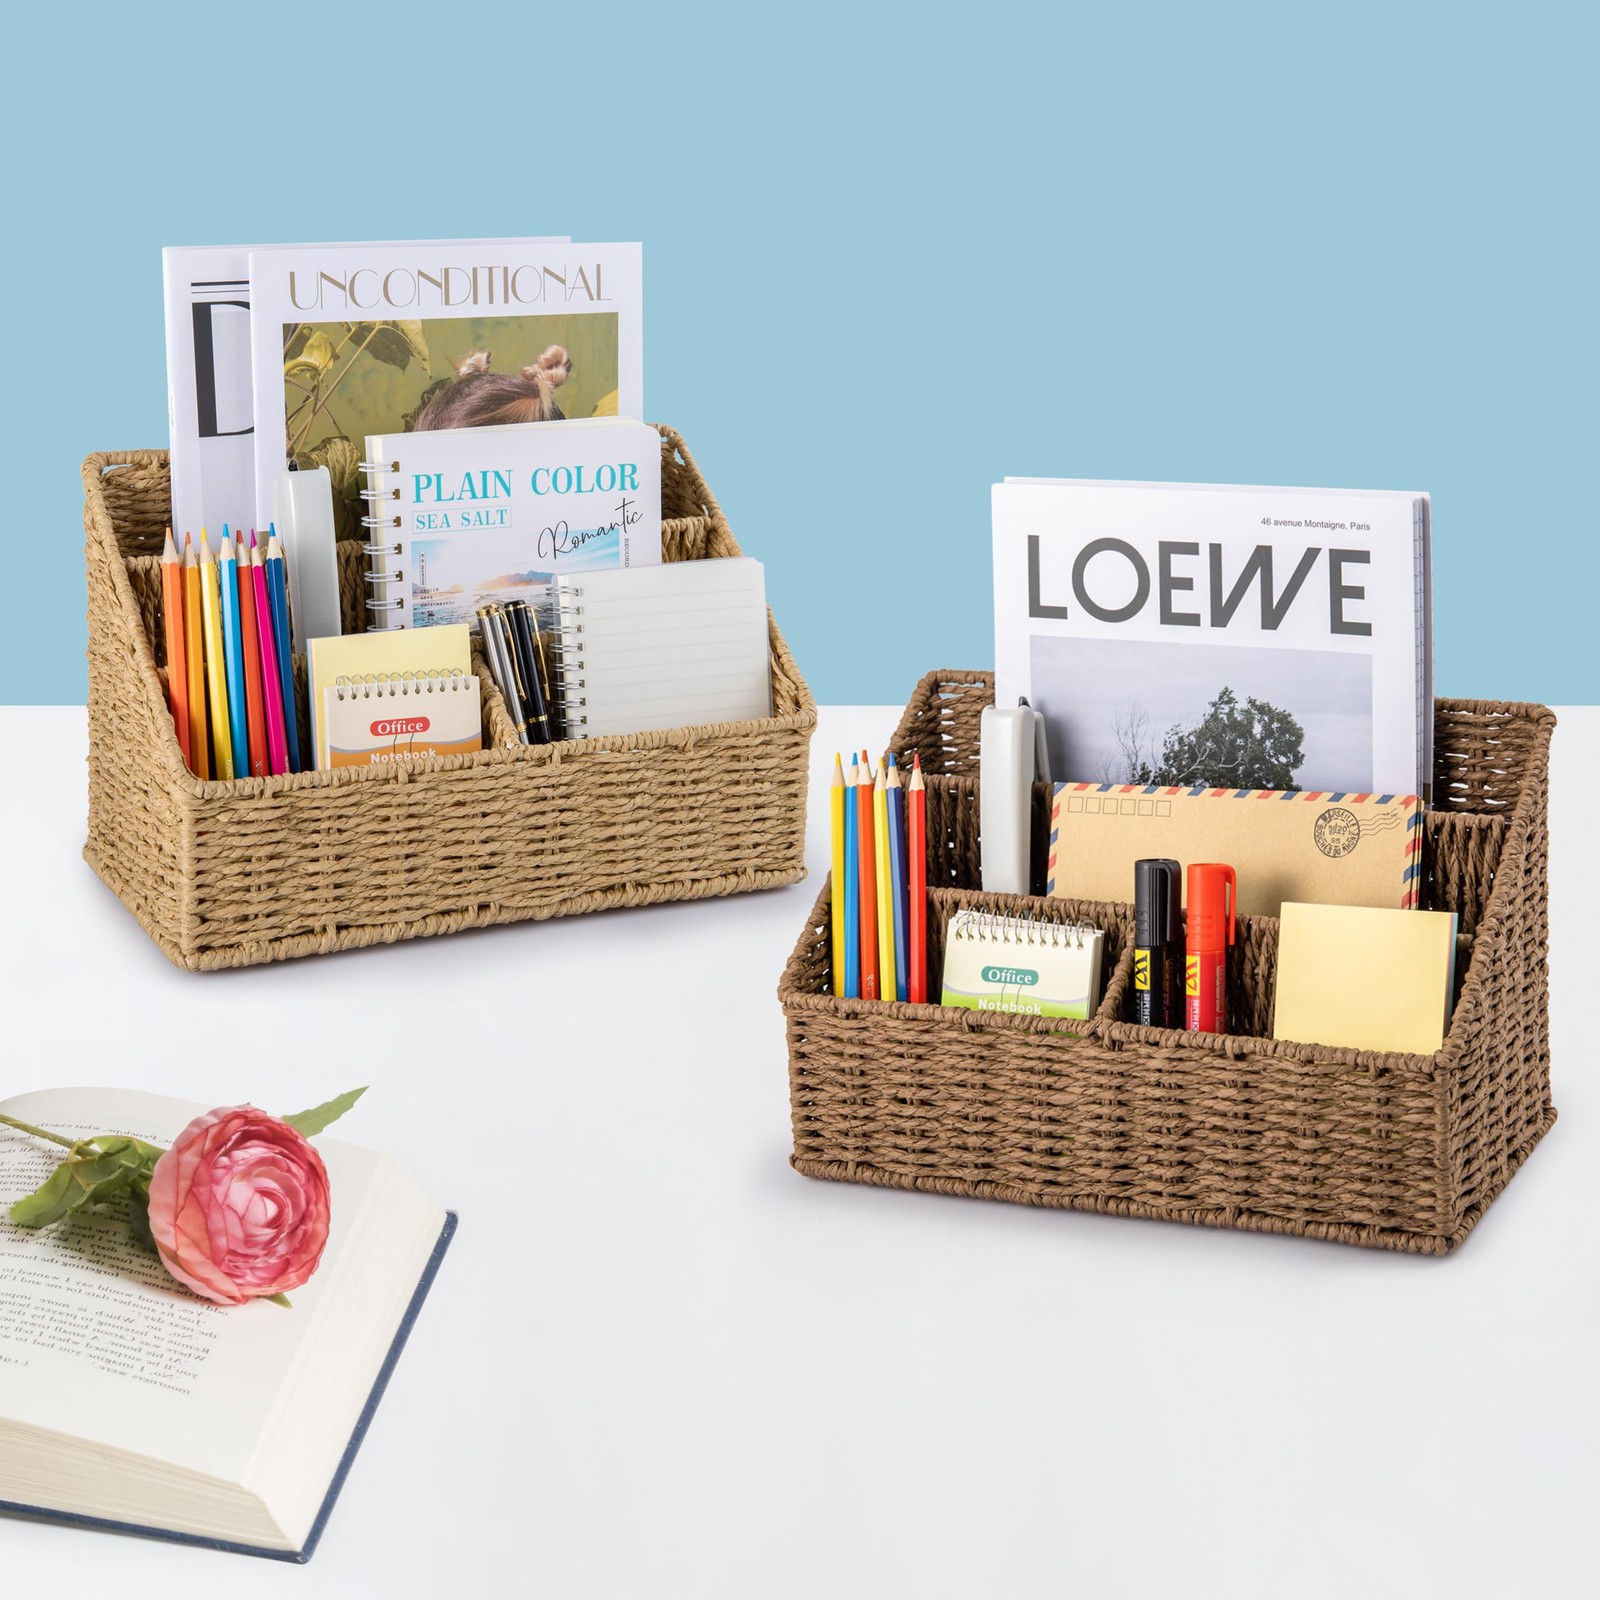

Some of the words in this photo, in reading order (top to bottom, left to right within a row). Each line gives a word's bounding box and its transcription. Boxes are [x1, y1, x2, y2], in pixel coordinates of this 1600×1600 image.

[288, 262, 613, 310] UNCONDITIONAL
[411, 468, 514, 504] PLAIN
[530, 463, 640, 496] COLOR
[415, 513, 451, 531] SEA
[461, 508, 508, 528] SALT
[537, 497, 644, 561] Romantic
[1261, 517, 1271, 527] 46
[1273, 520, 1302, 528] avenue
[1304, 519, 1348, 531] Montaigne,
[1349, 521, 1371, 531] Paris
[1027, 533, 1373, 637] LOEWE
[377, 718, 425, 734] Office
[370, 747, 437, 764] Notebook
[988, 967, 1033, 985] Office
[978, 997, 1042, 1016] Notebook
